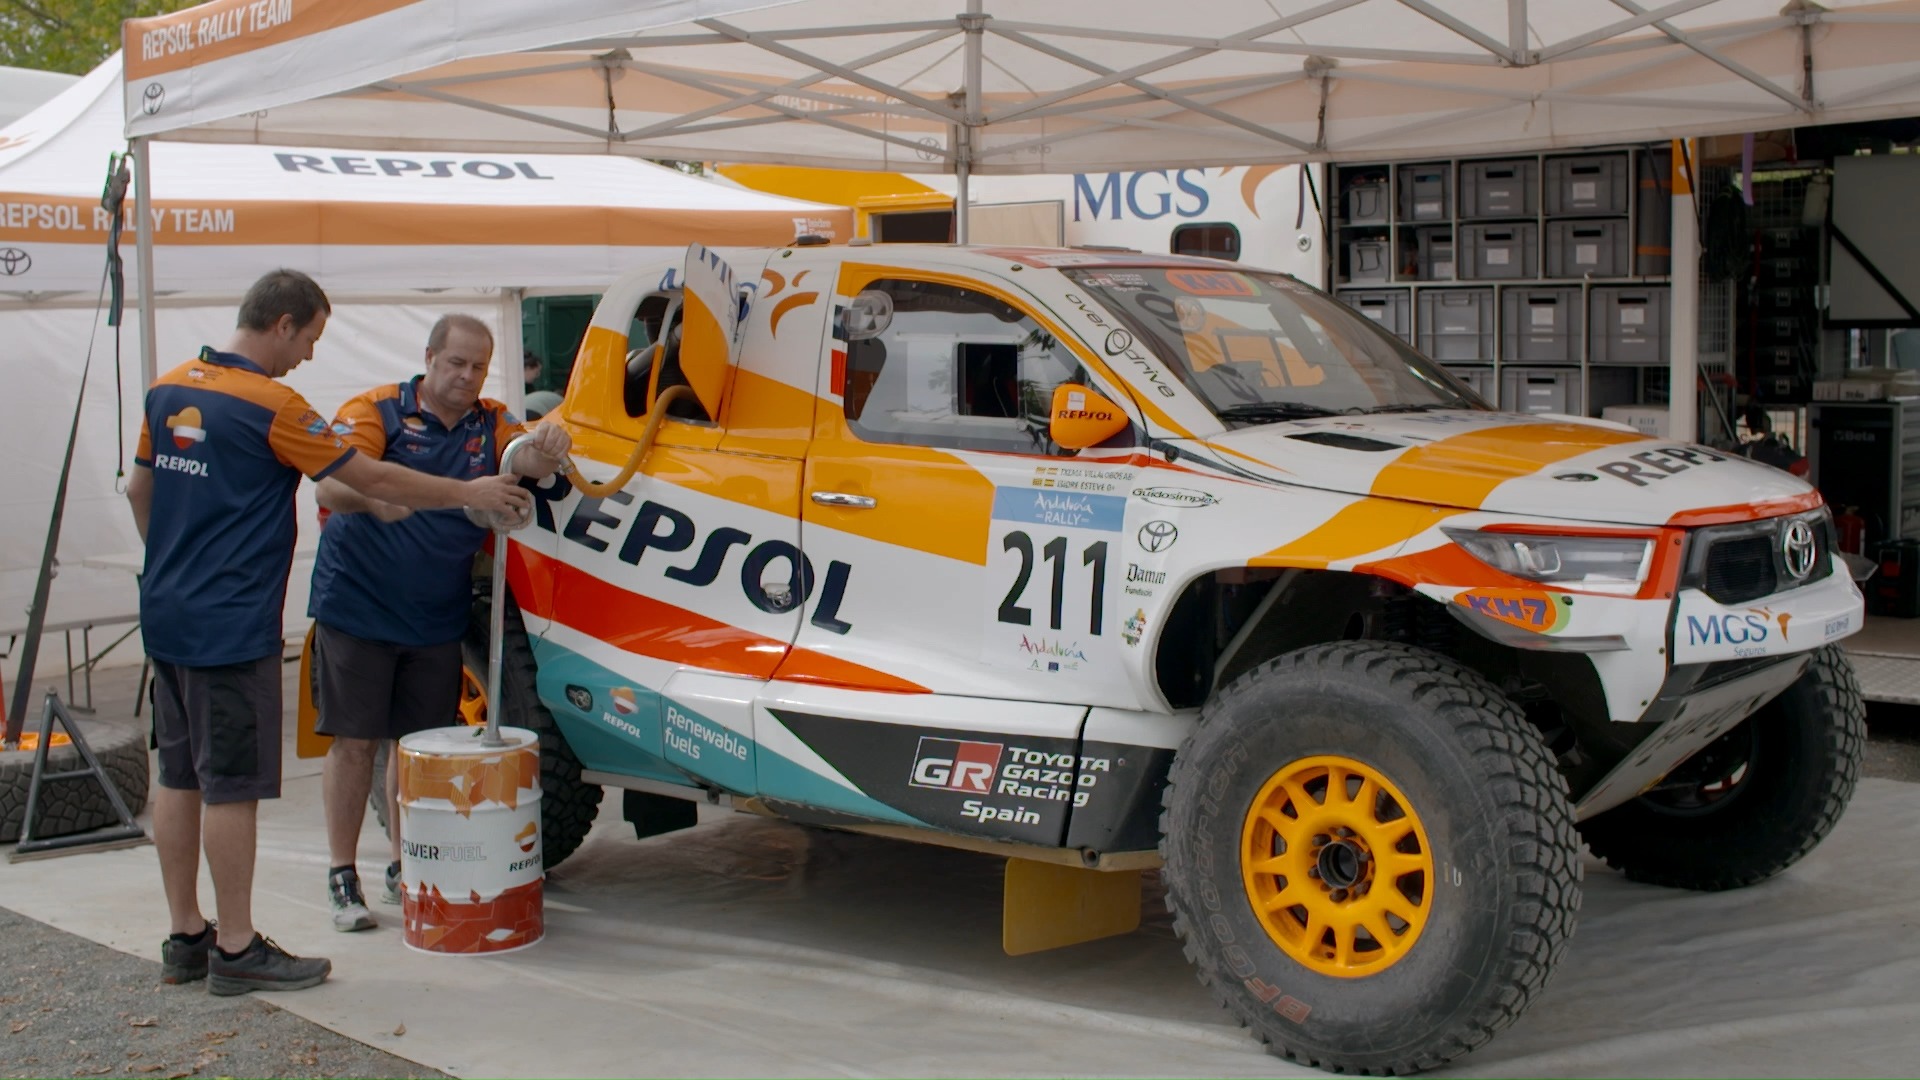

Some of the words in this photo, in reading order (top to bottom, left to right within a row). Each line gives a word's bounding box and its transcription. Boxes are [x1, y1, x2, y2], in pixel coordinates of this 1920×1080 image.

[143, 23, 194, 60] REPSOL
[198, 6, 246, 46] RALLY
[250, 0, 292, 32] TEAM
[274, 153, 554, 180] REPSOL
[1073, 168, 1210, 221] MGS
[171, 208, 234, 232] TEAM
[1059, 410, 1112, 421] REPSOL
[155, 453, 208, 477] REPSOL
[1034, 492, 1093, 514] Andalucía
[1132, 487, 1221, 506] Guidosimplex
[1044, 511, 1081, 526] RALLY
[518, 471, 852, 635] REPSOL
[998, 530, 1108, 636] 211
[1126, 563, 1166, 585] Damm
[1687, 614, 1768, 646] MGS
[1019, 634, 1088, 662] Andalucía
[1734, 646, 1767, 657] Seguros
[603, 712, 641, 738] REPSOL
[667, 706, 747, 760] Renewable
[664, 727, 700, 760] fuels
[1008, 747, 1110, 772] TOYOTA
[914, 758, 993, 790] GR
[1002, 764, 1097, 787] GAZOO
[997, 780, 1090, 807] Racing
[960, 800, 1041, 825] Spain
